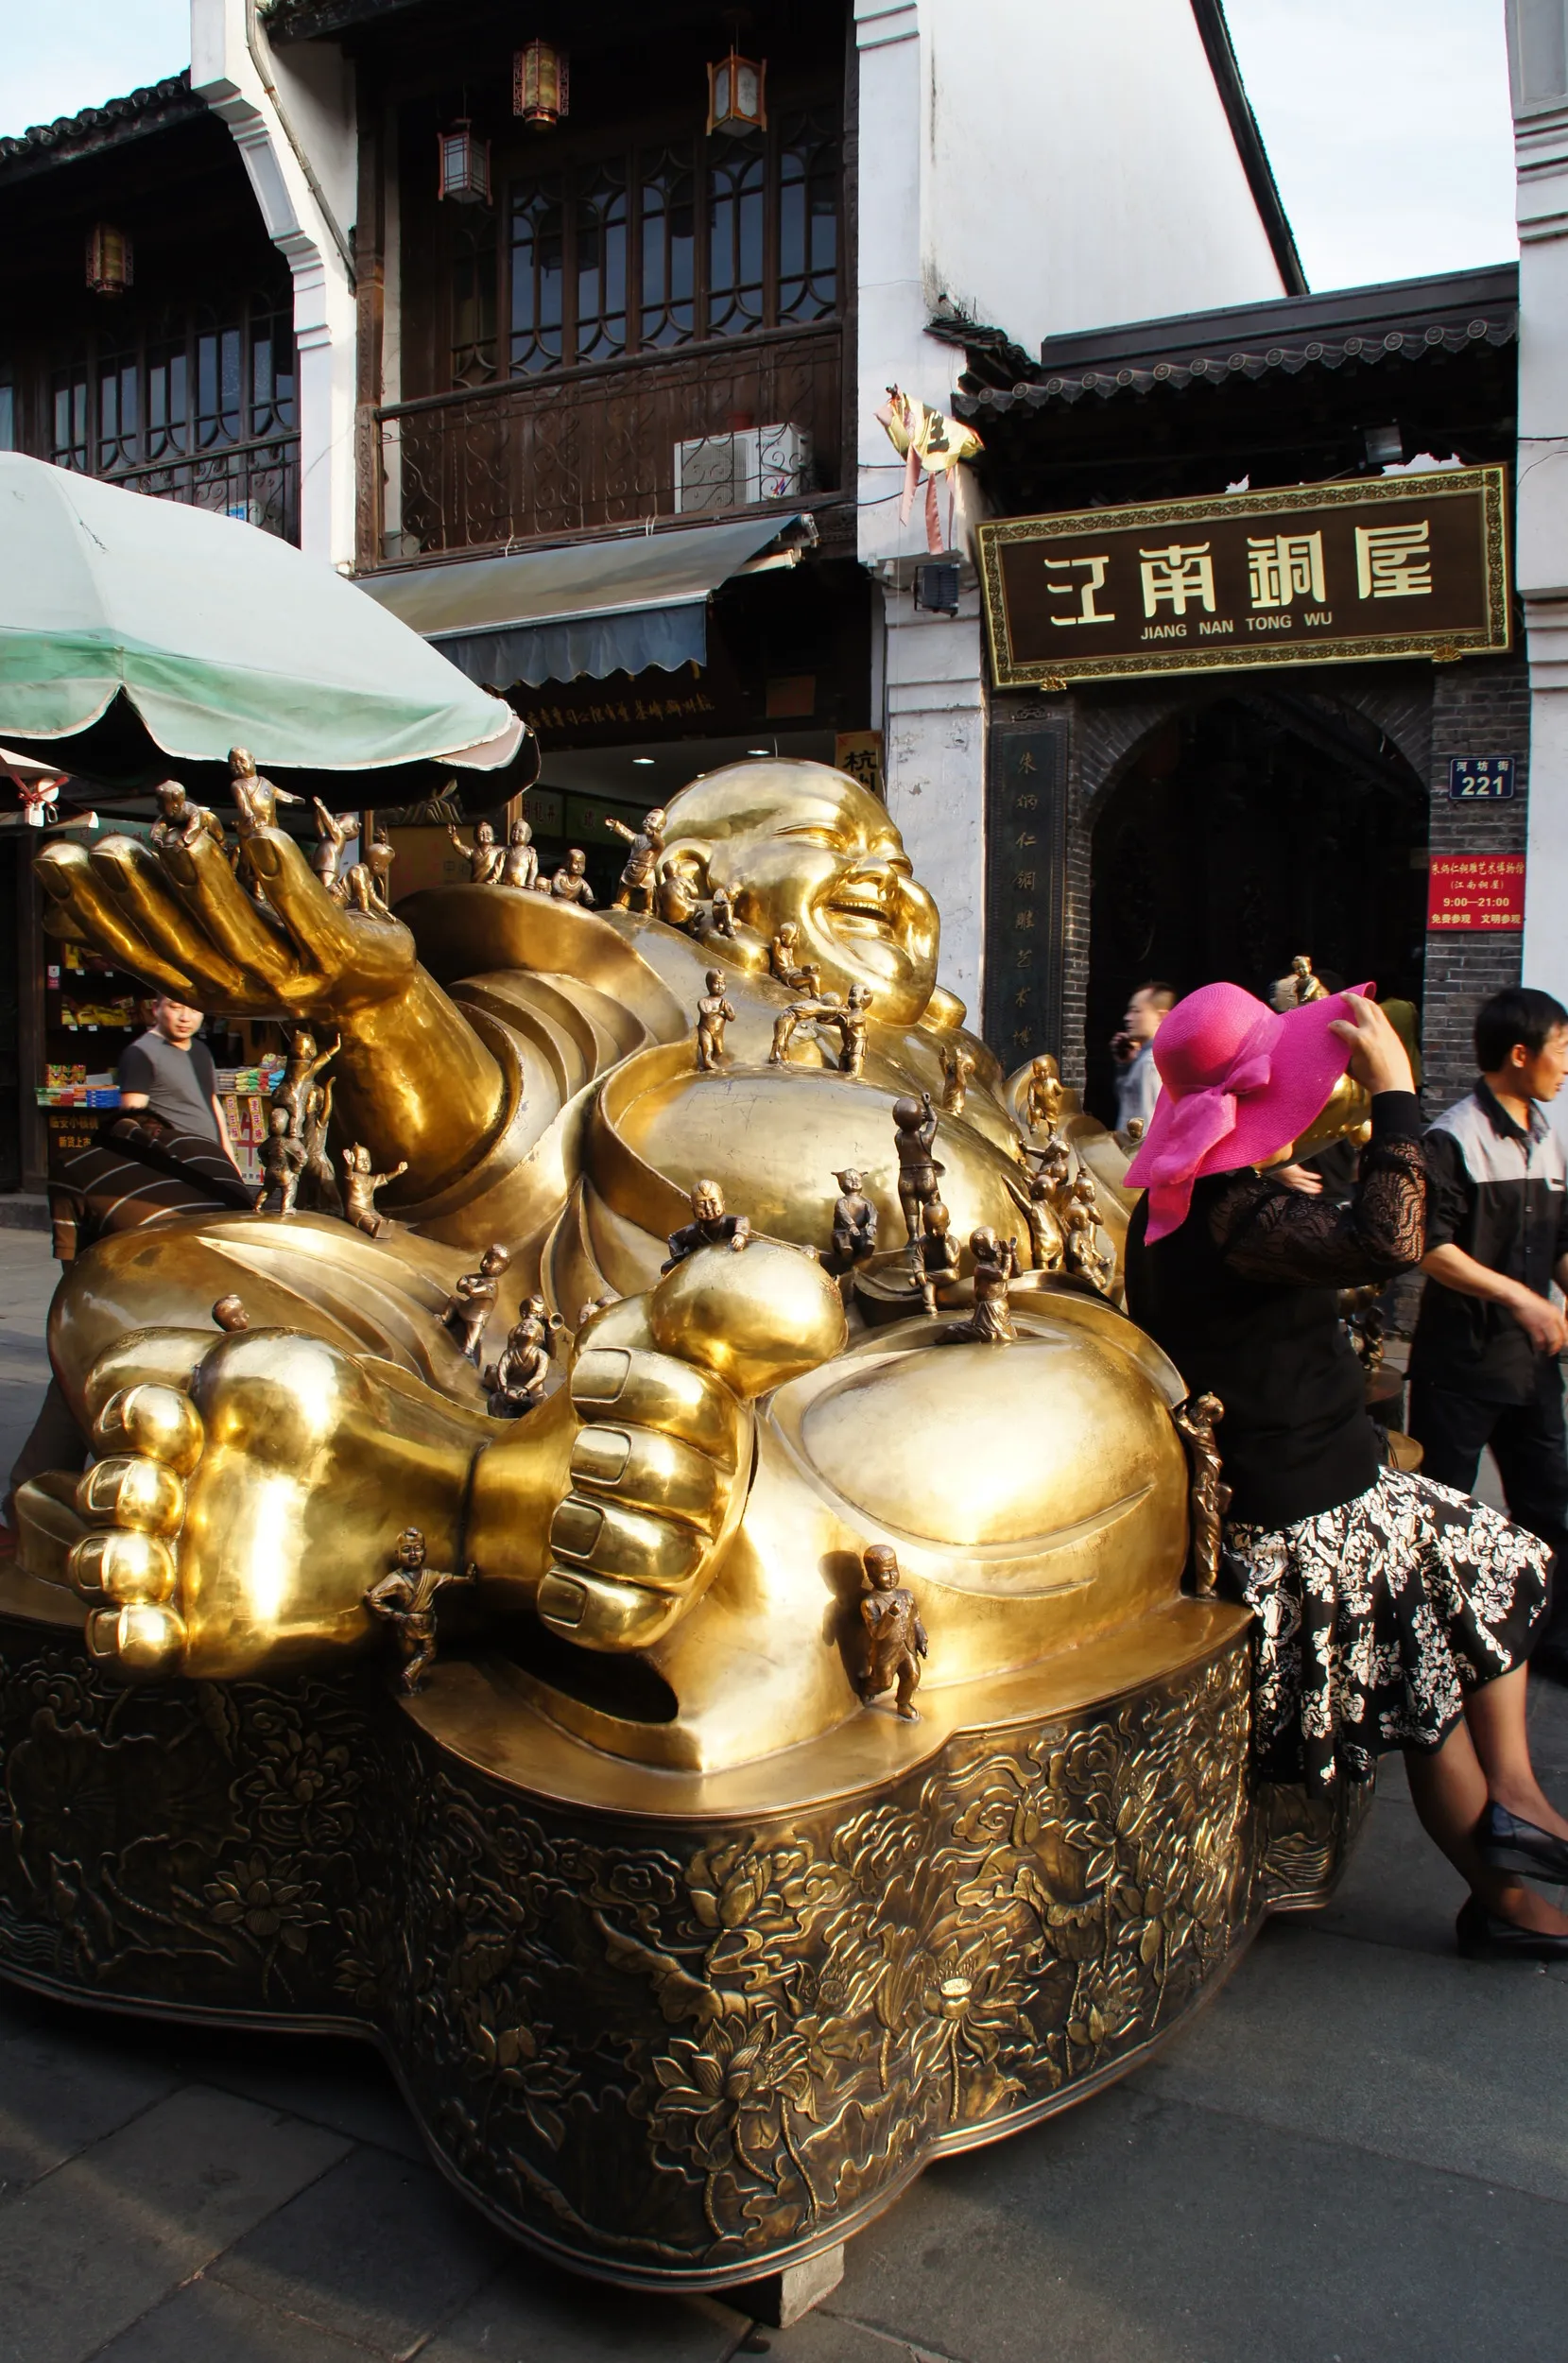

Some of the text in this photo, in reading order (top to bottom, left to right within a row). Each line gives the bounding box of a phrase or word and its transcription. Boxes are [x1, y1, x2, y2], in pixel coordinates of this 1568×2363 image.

[1140, 611, 1333, 640] JIANG NAN TONG WU
[1456, 761, 1508, 772] 河坊街
[1461, 776, 1503, 796] 221
[1431, 913, 1522, 924] 免费参观 文明参观
